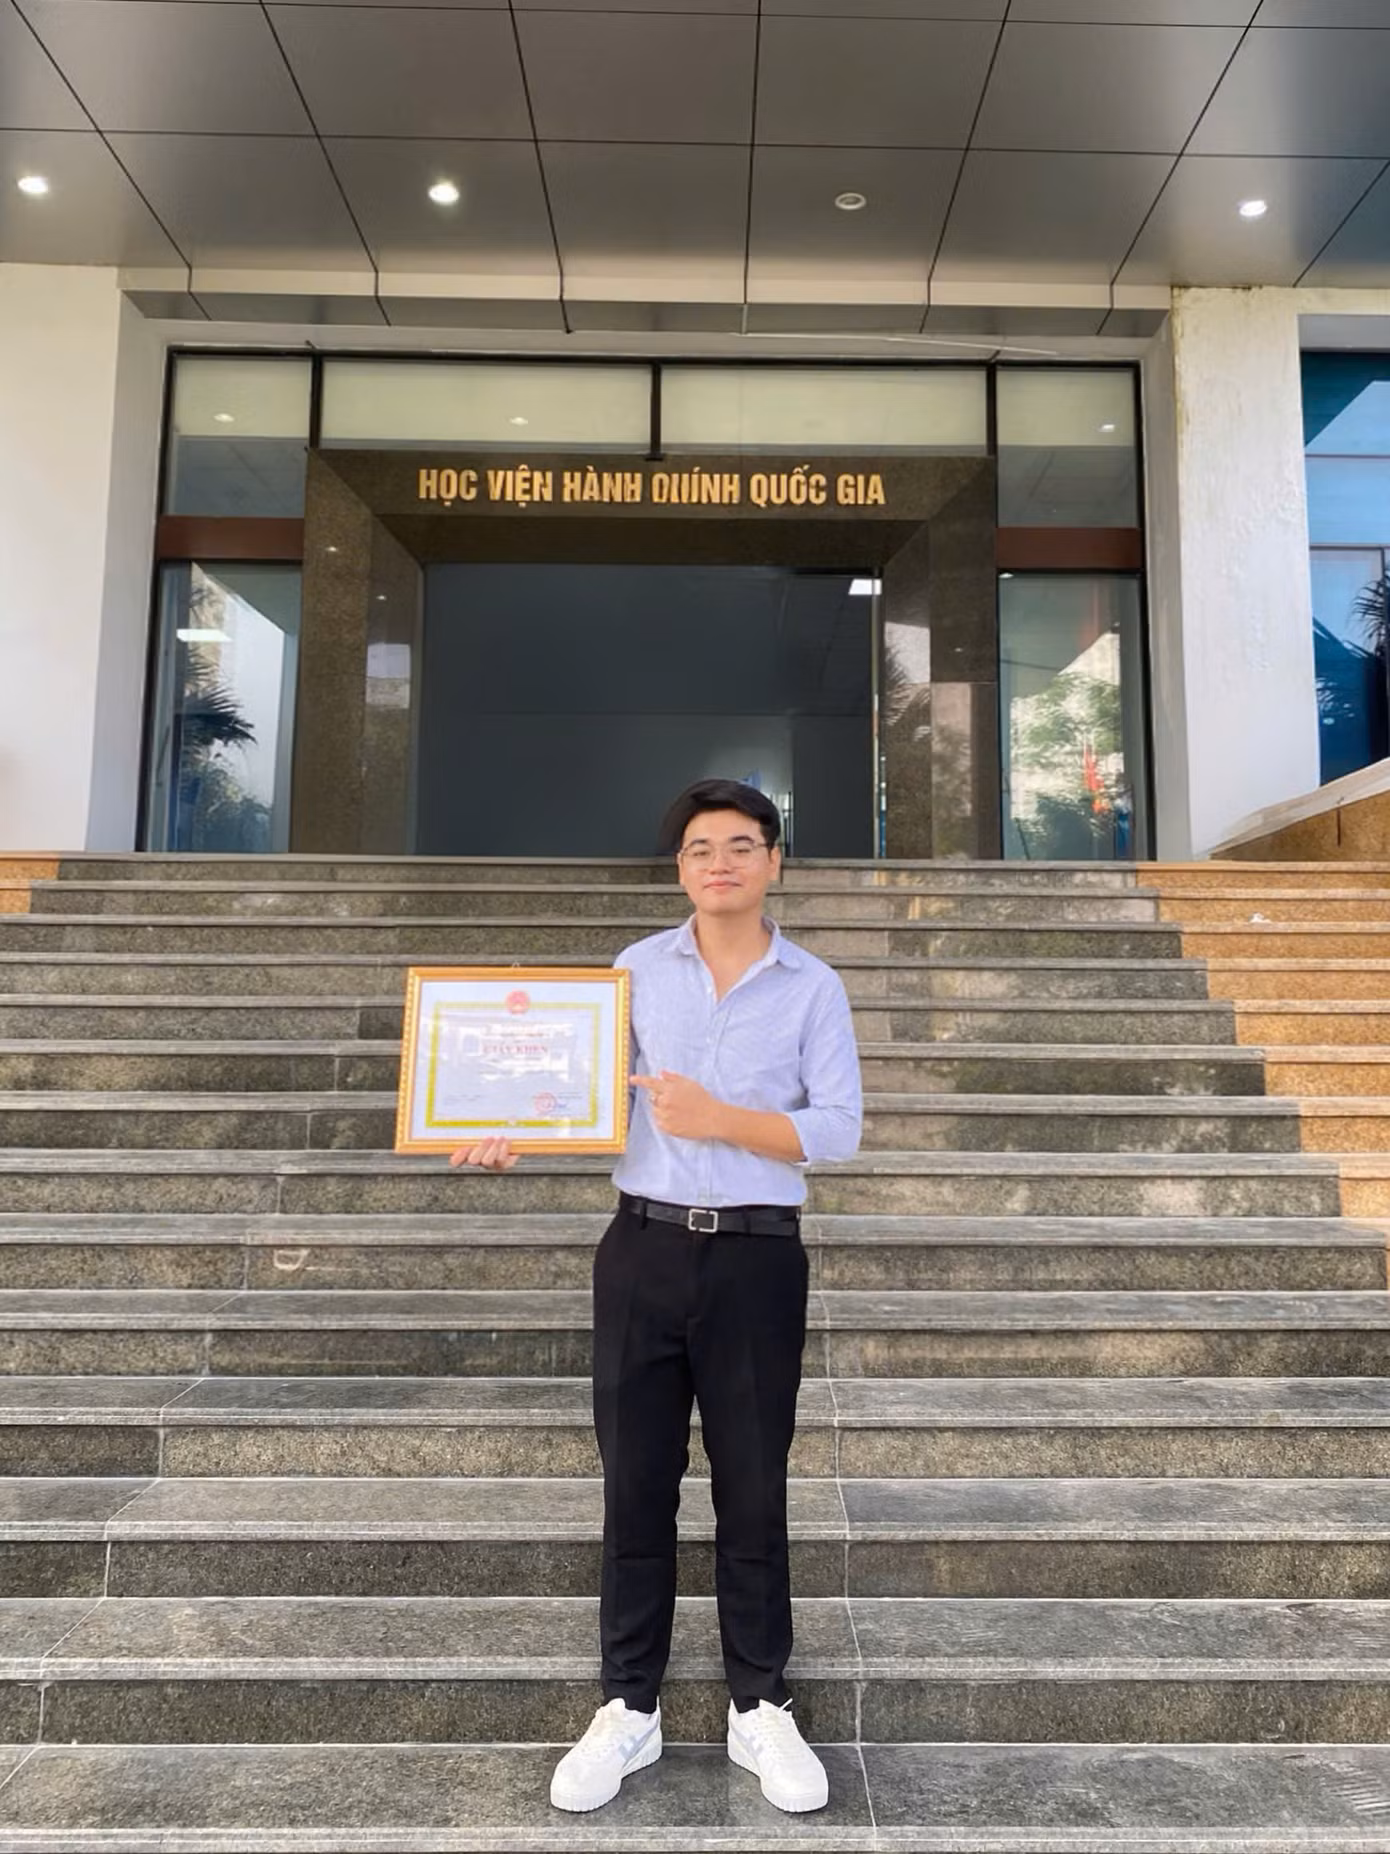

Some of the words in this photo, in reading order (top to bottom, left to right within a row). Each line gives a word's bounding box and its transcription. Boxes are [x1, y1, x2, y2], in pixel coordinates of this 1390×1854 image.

[418, 469, 478, 507] HỌC
[487, 464, 553, 508] VIỆN
[562, 465, 643, 503] HÀNH
[750, 464, 827, 508] QUỐC
[836, 473, 886, 505] GIA
